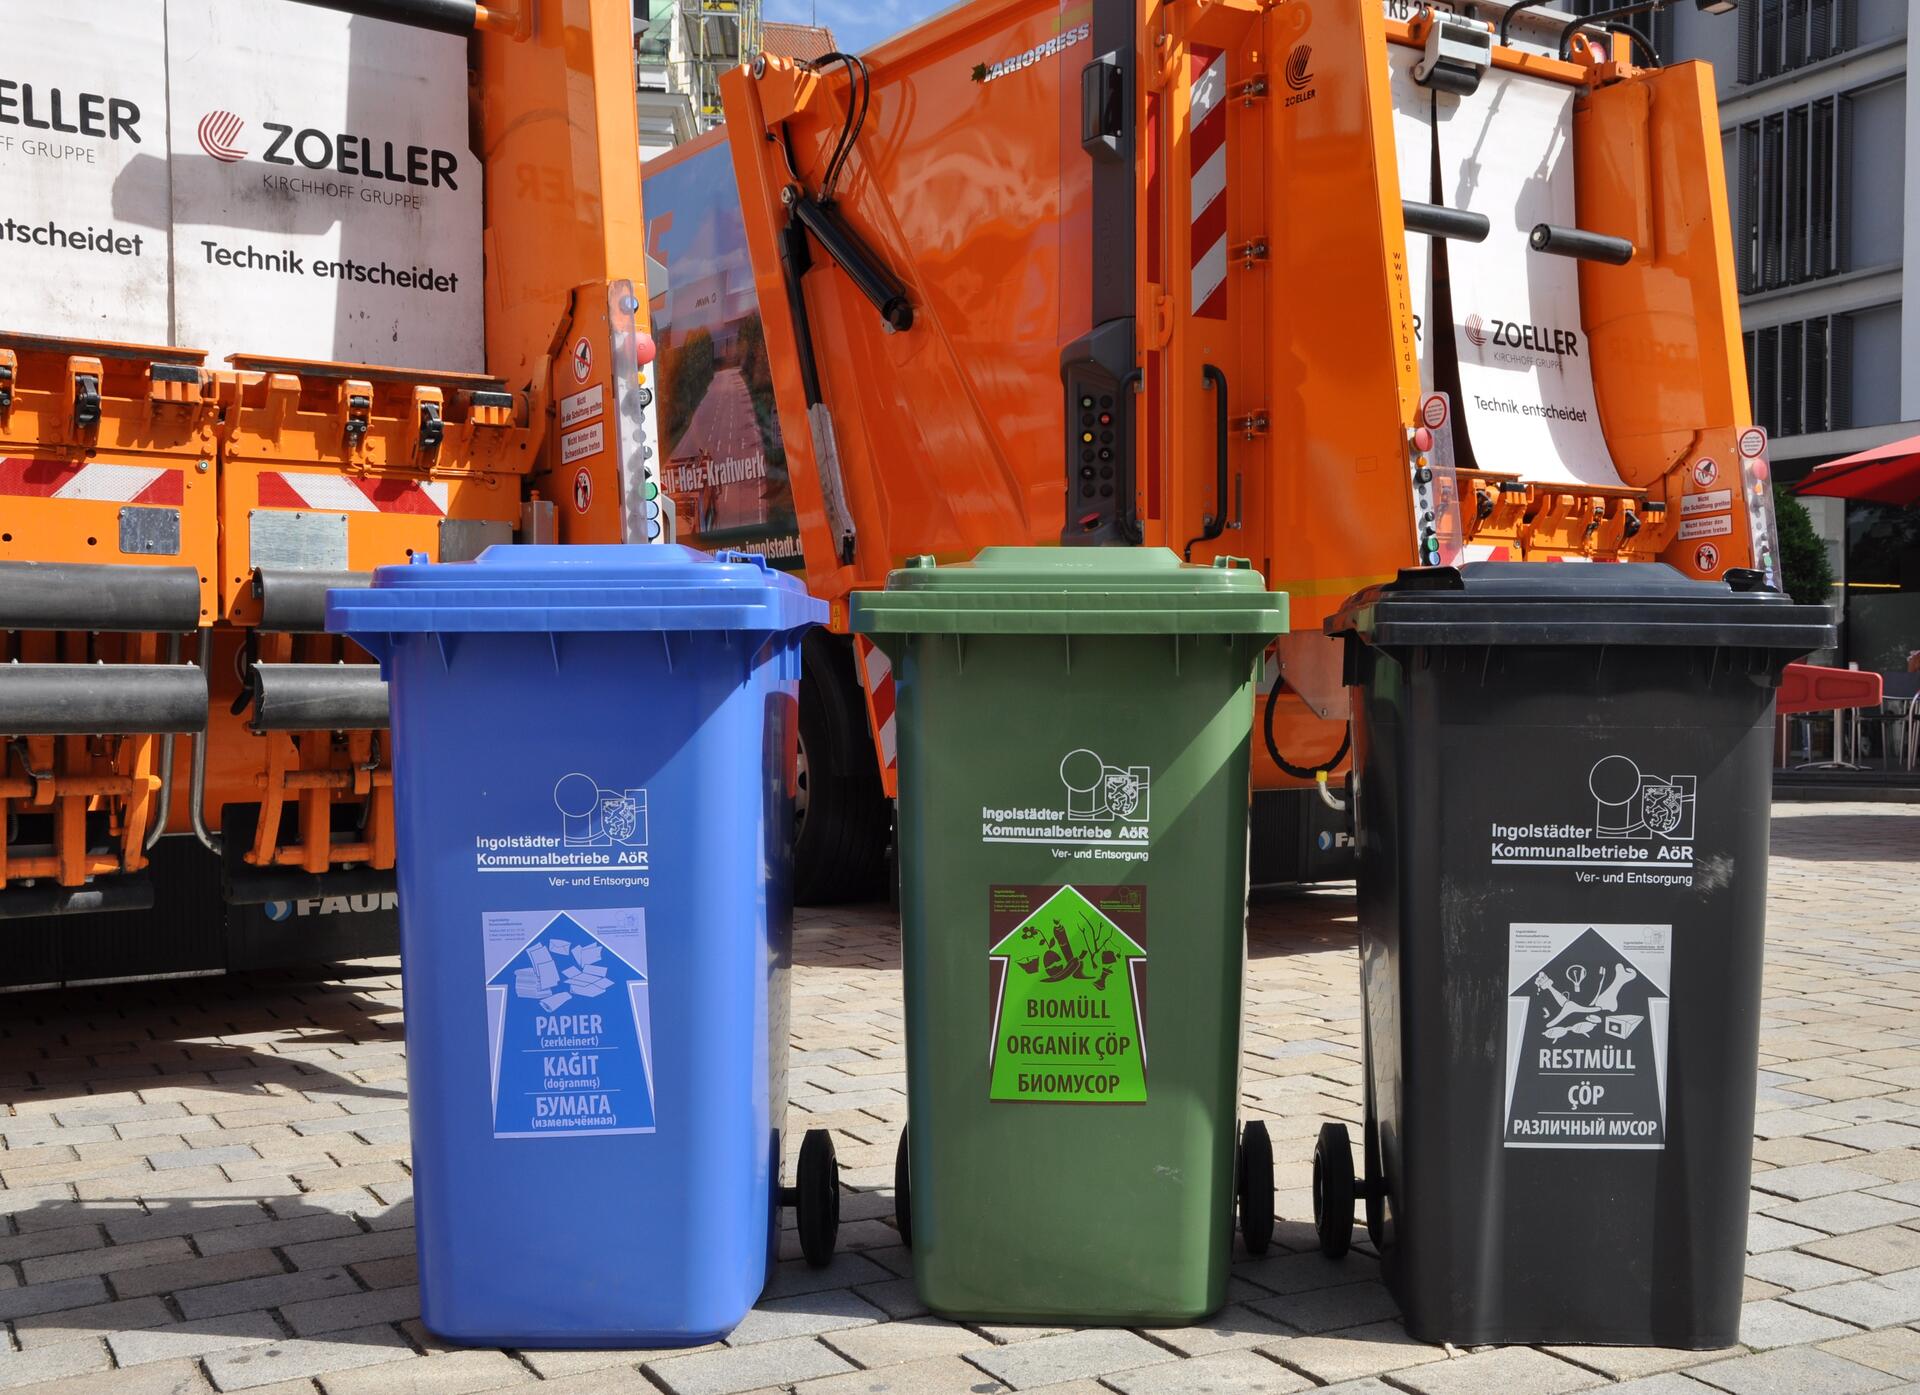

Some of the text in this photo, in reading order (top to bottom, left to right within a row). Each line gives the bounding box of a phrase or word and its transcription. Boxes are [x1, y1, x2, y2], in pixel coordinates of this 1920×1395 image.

[1285, 89, 1316, 107] ZOELLER
[22, 139, 96, 164] GRUPPE
[262, 121, 459, 191] ZOELLER
[263, 173, 421, 210] KIRCHHOFF GRUPPE
[201, 240, 459, 293] Technik entscheidet
[1491, 319, 1579, 357] ZOELLER
[1494, 351, 1533, 366] KIRCHHOFF
[1474, 395, 1587, 422] Technik entscheidet
[983, 807, 1065, 822] Ingolstädter
[983, 824, 1149, 839] Kommunalbetriebe AöR
[1491, 823, 1593, 842] Ingolstädter
[476, 835, 561, 851] Ingolstädter
[1491, 843, 1694, 860] Kommunalbetriebe AöR
[476, 851, 648, 866] Kommunalbetriebe AöR
[1051, 848, 1149, 862] Ver- und Entsorgung
[549, 876, 650, 887] Ver- und Entsorgung
[1575, 871, 1693, 887] Ver- und Entsorgung
[1027, 995, 1110, 1019] BIOMÜLL
[535, 1014, 603, 1036] PAPIER
[540, 1036, 599, 1049] (zerkleinert)
[1007, 1032, 1131, 1061] ORGANİK ÇÖP
[543, 1052, 599, 1077] KAĞIT
[1539, 1045, 1636, 1070] RESTMÜLL
[543, 1076, 600, 1090] (doğranmış)
[1018, 1073, 1121, 1094] БИОМУСОР
[1567, 1080, 1605, 1111] ÇÖP
[535, 1094, 611, 1117] БУМАГА
[531, 1114, 617, 1129] (измельчённая)
[1513, 1117, 1658, 1136] РАЗЛИЧНЫЙ МУСОР
